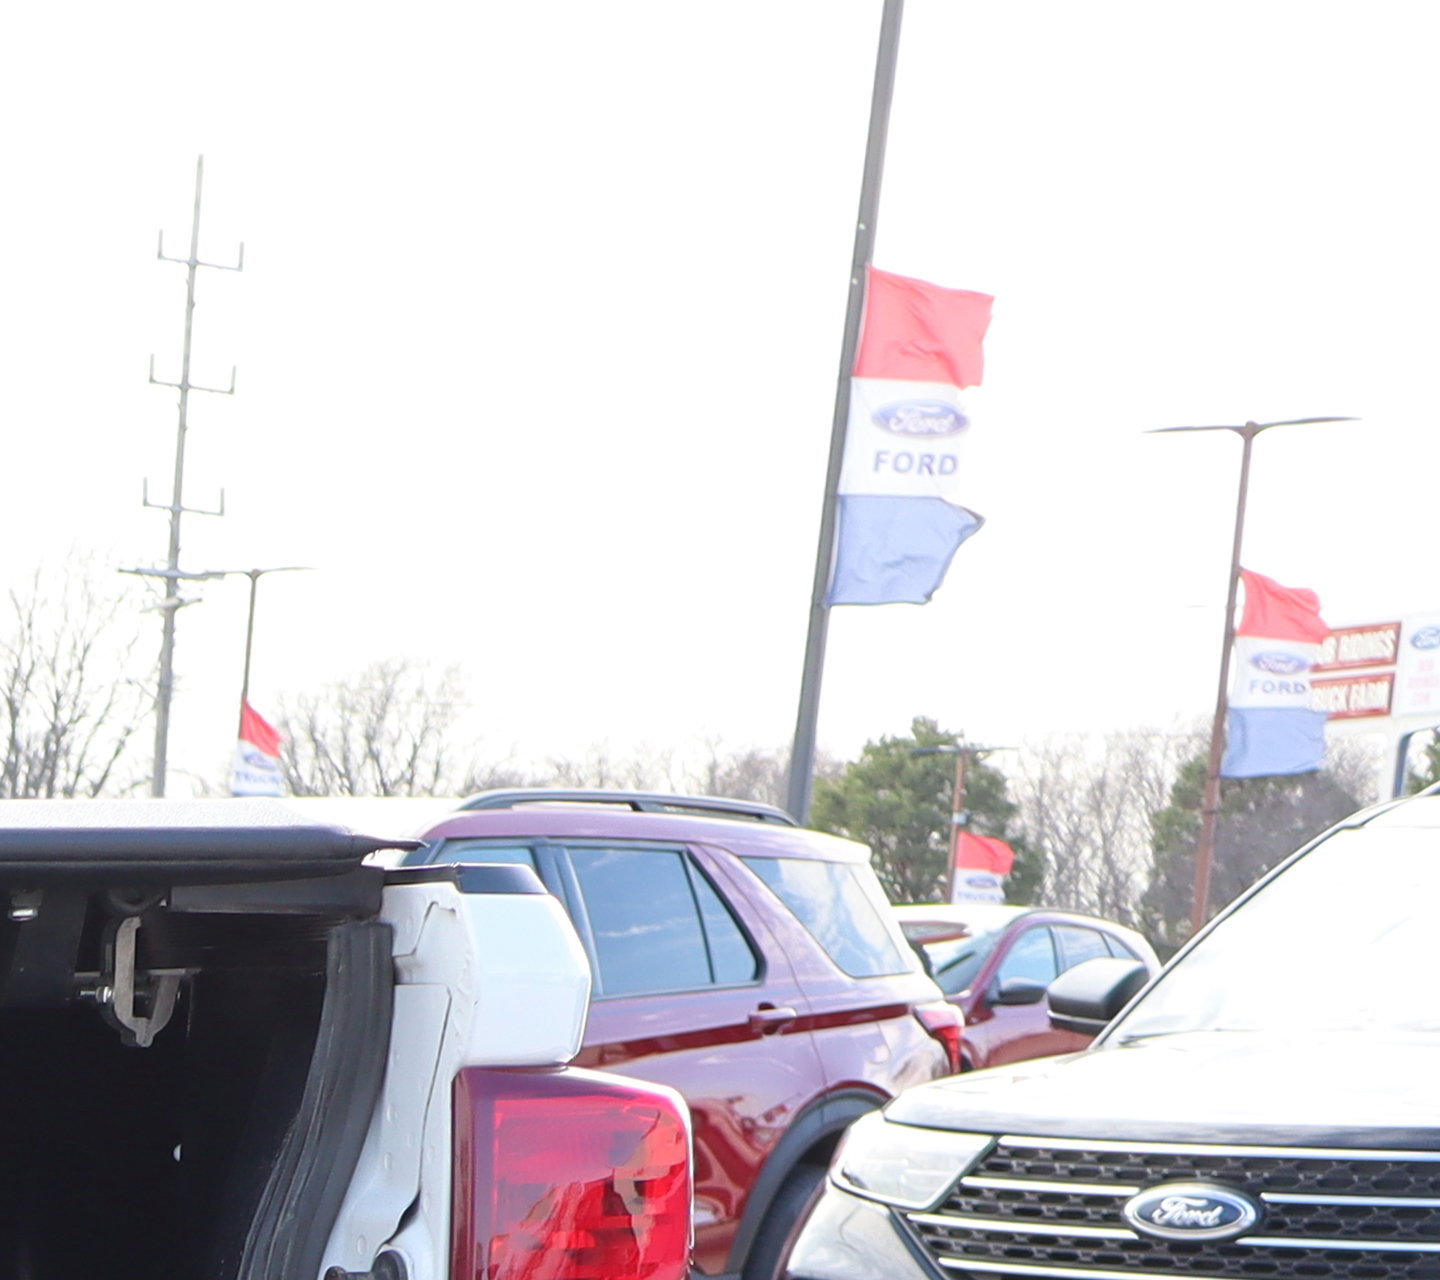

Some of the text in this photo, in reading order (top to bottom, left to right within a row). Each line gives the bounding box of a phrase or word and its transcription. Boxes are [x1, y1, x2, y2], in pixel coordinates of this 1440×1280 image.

[889, 404, 956, 433] Ford
[873, 450, 960, 476] FORD
[1248, 678, 1307, 696] FORD
[1152, 1196, 1224, 1227] Ford
